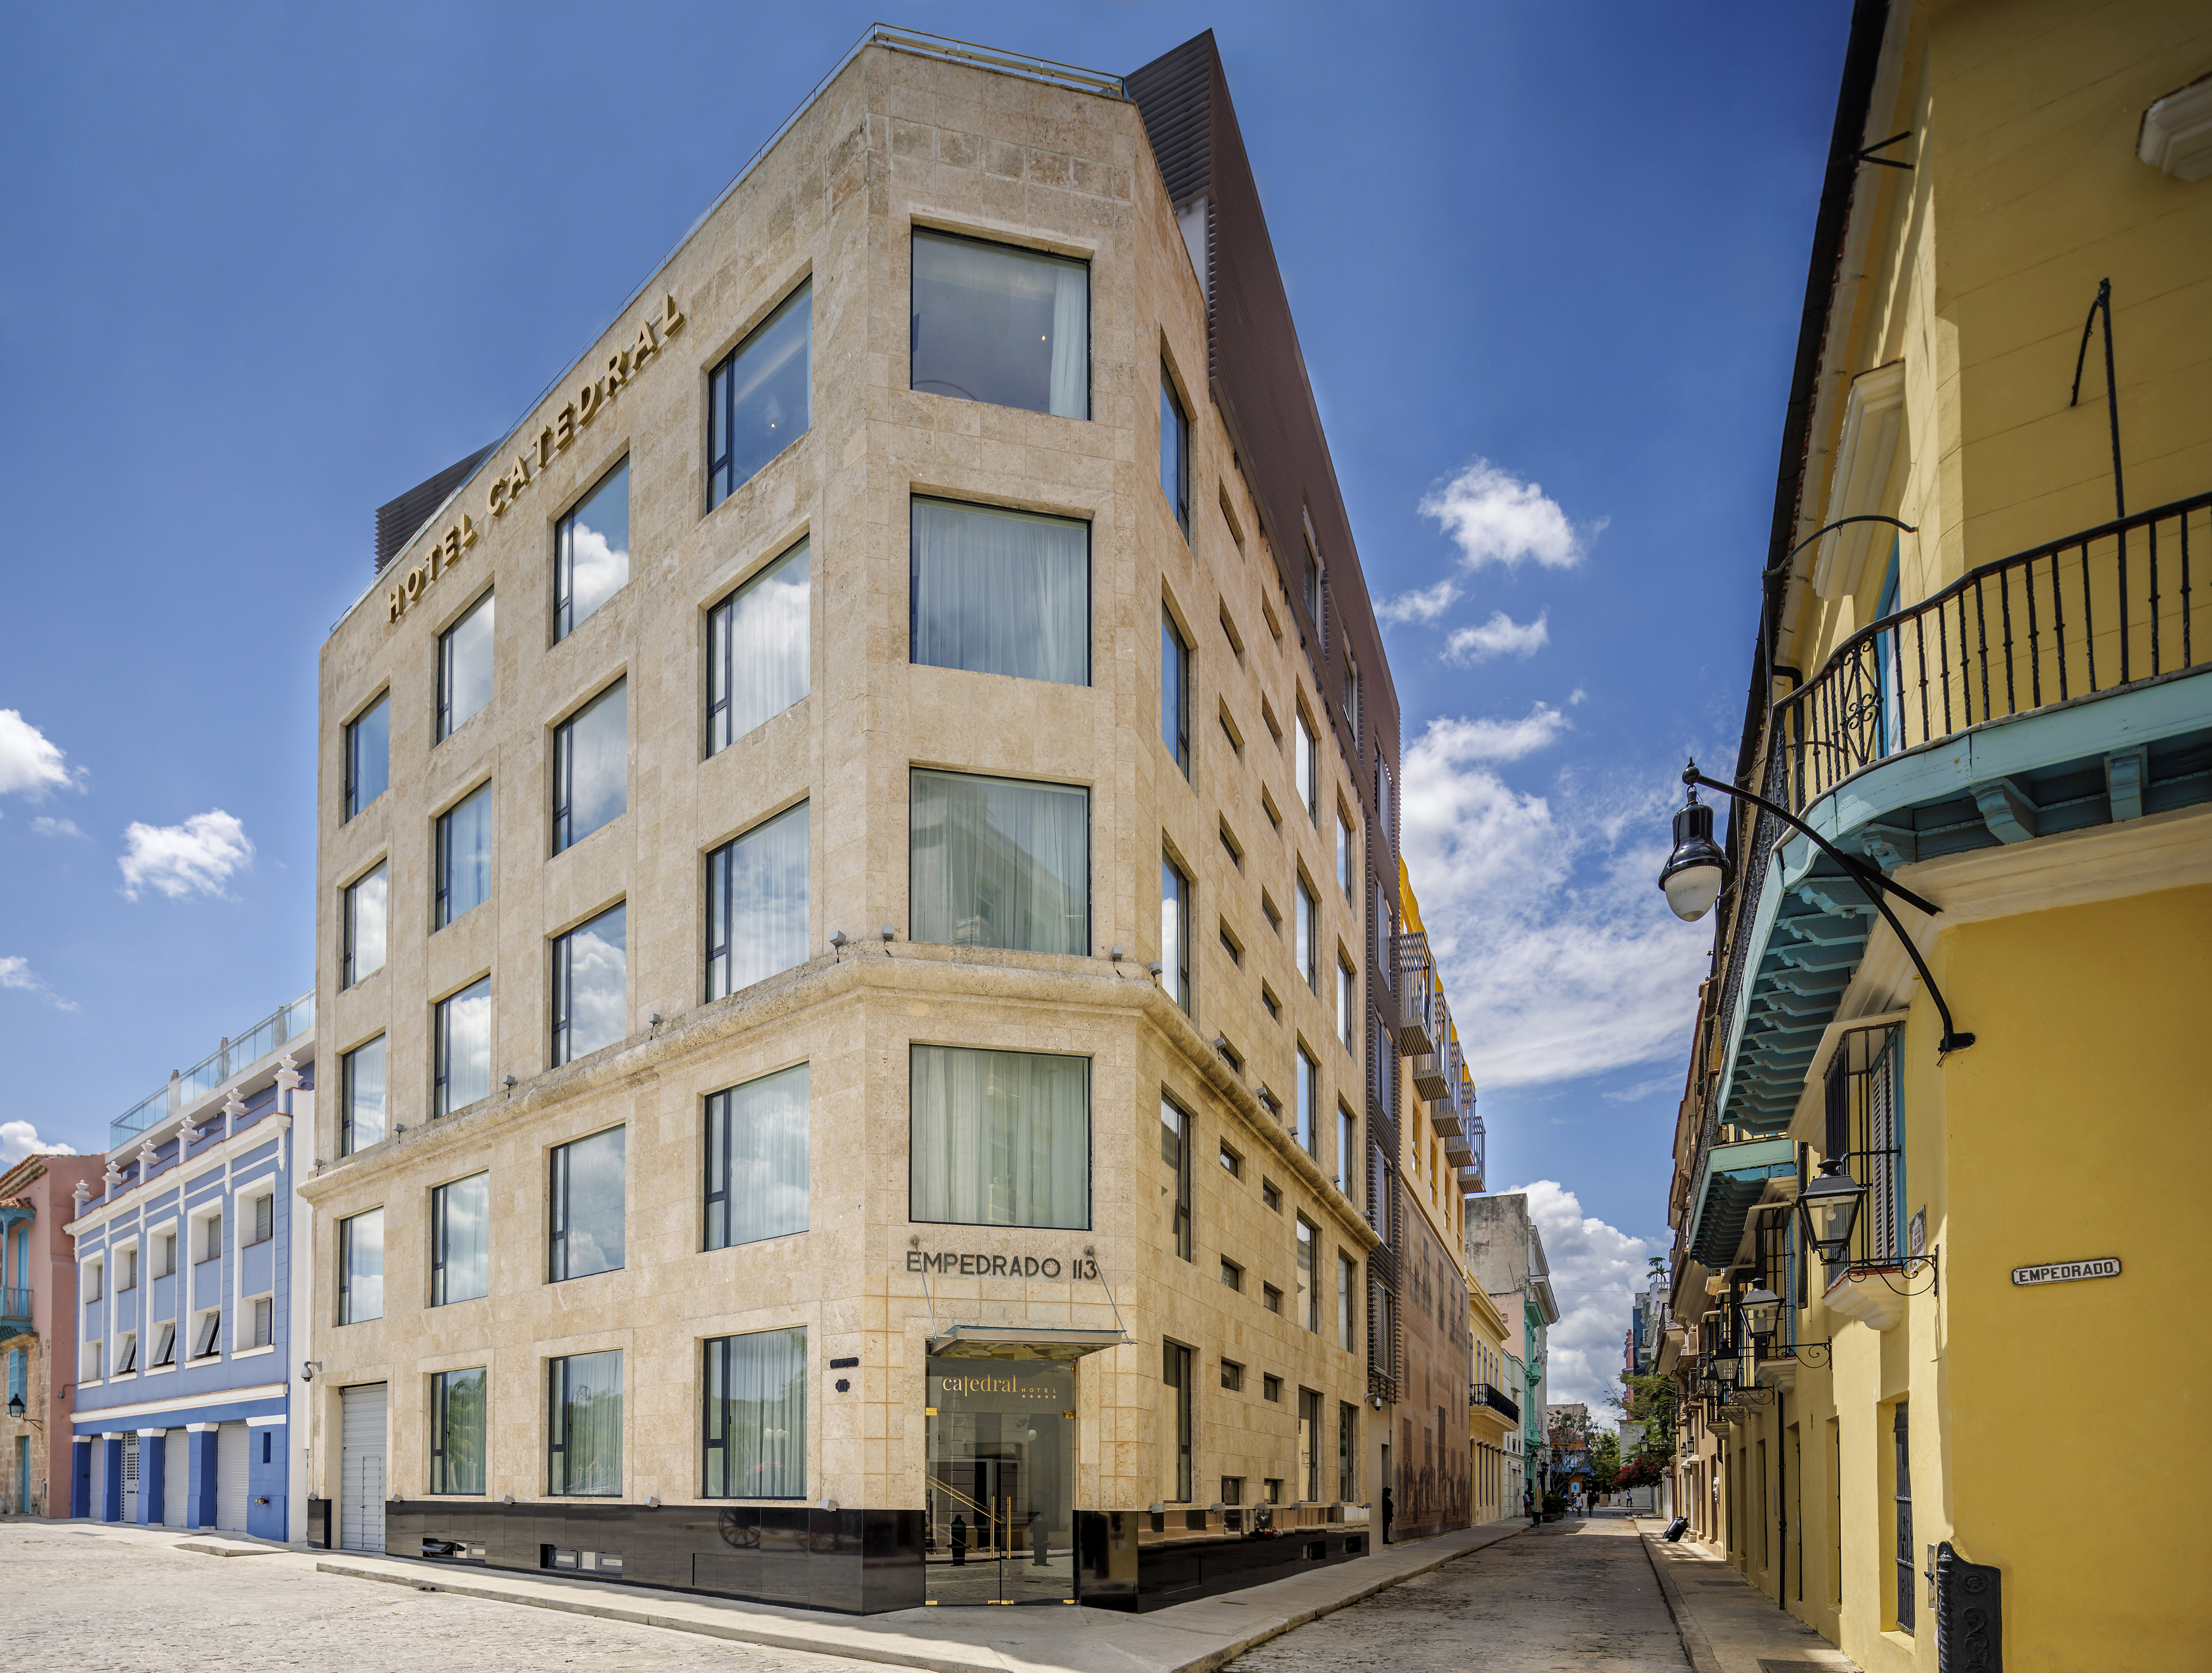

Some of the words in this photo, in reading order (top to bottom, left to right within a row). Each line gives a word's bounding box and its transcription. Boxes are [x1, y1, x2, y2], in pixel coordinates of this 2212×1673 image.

[388, 512, 478, 624] HOTEL
[486, 292, 685, 518] CATEDRAL
[906, 1251, 1061, 1278] EMPEDRADO
[1073, 1259, 1097, 1280] 113
[2019, 1261, 2114, 1282] EMPEDRADO
[942, 1374, 1017, 1397] catedral
